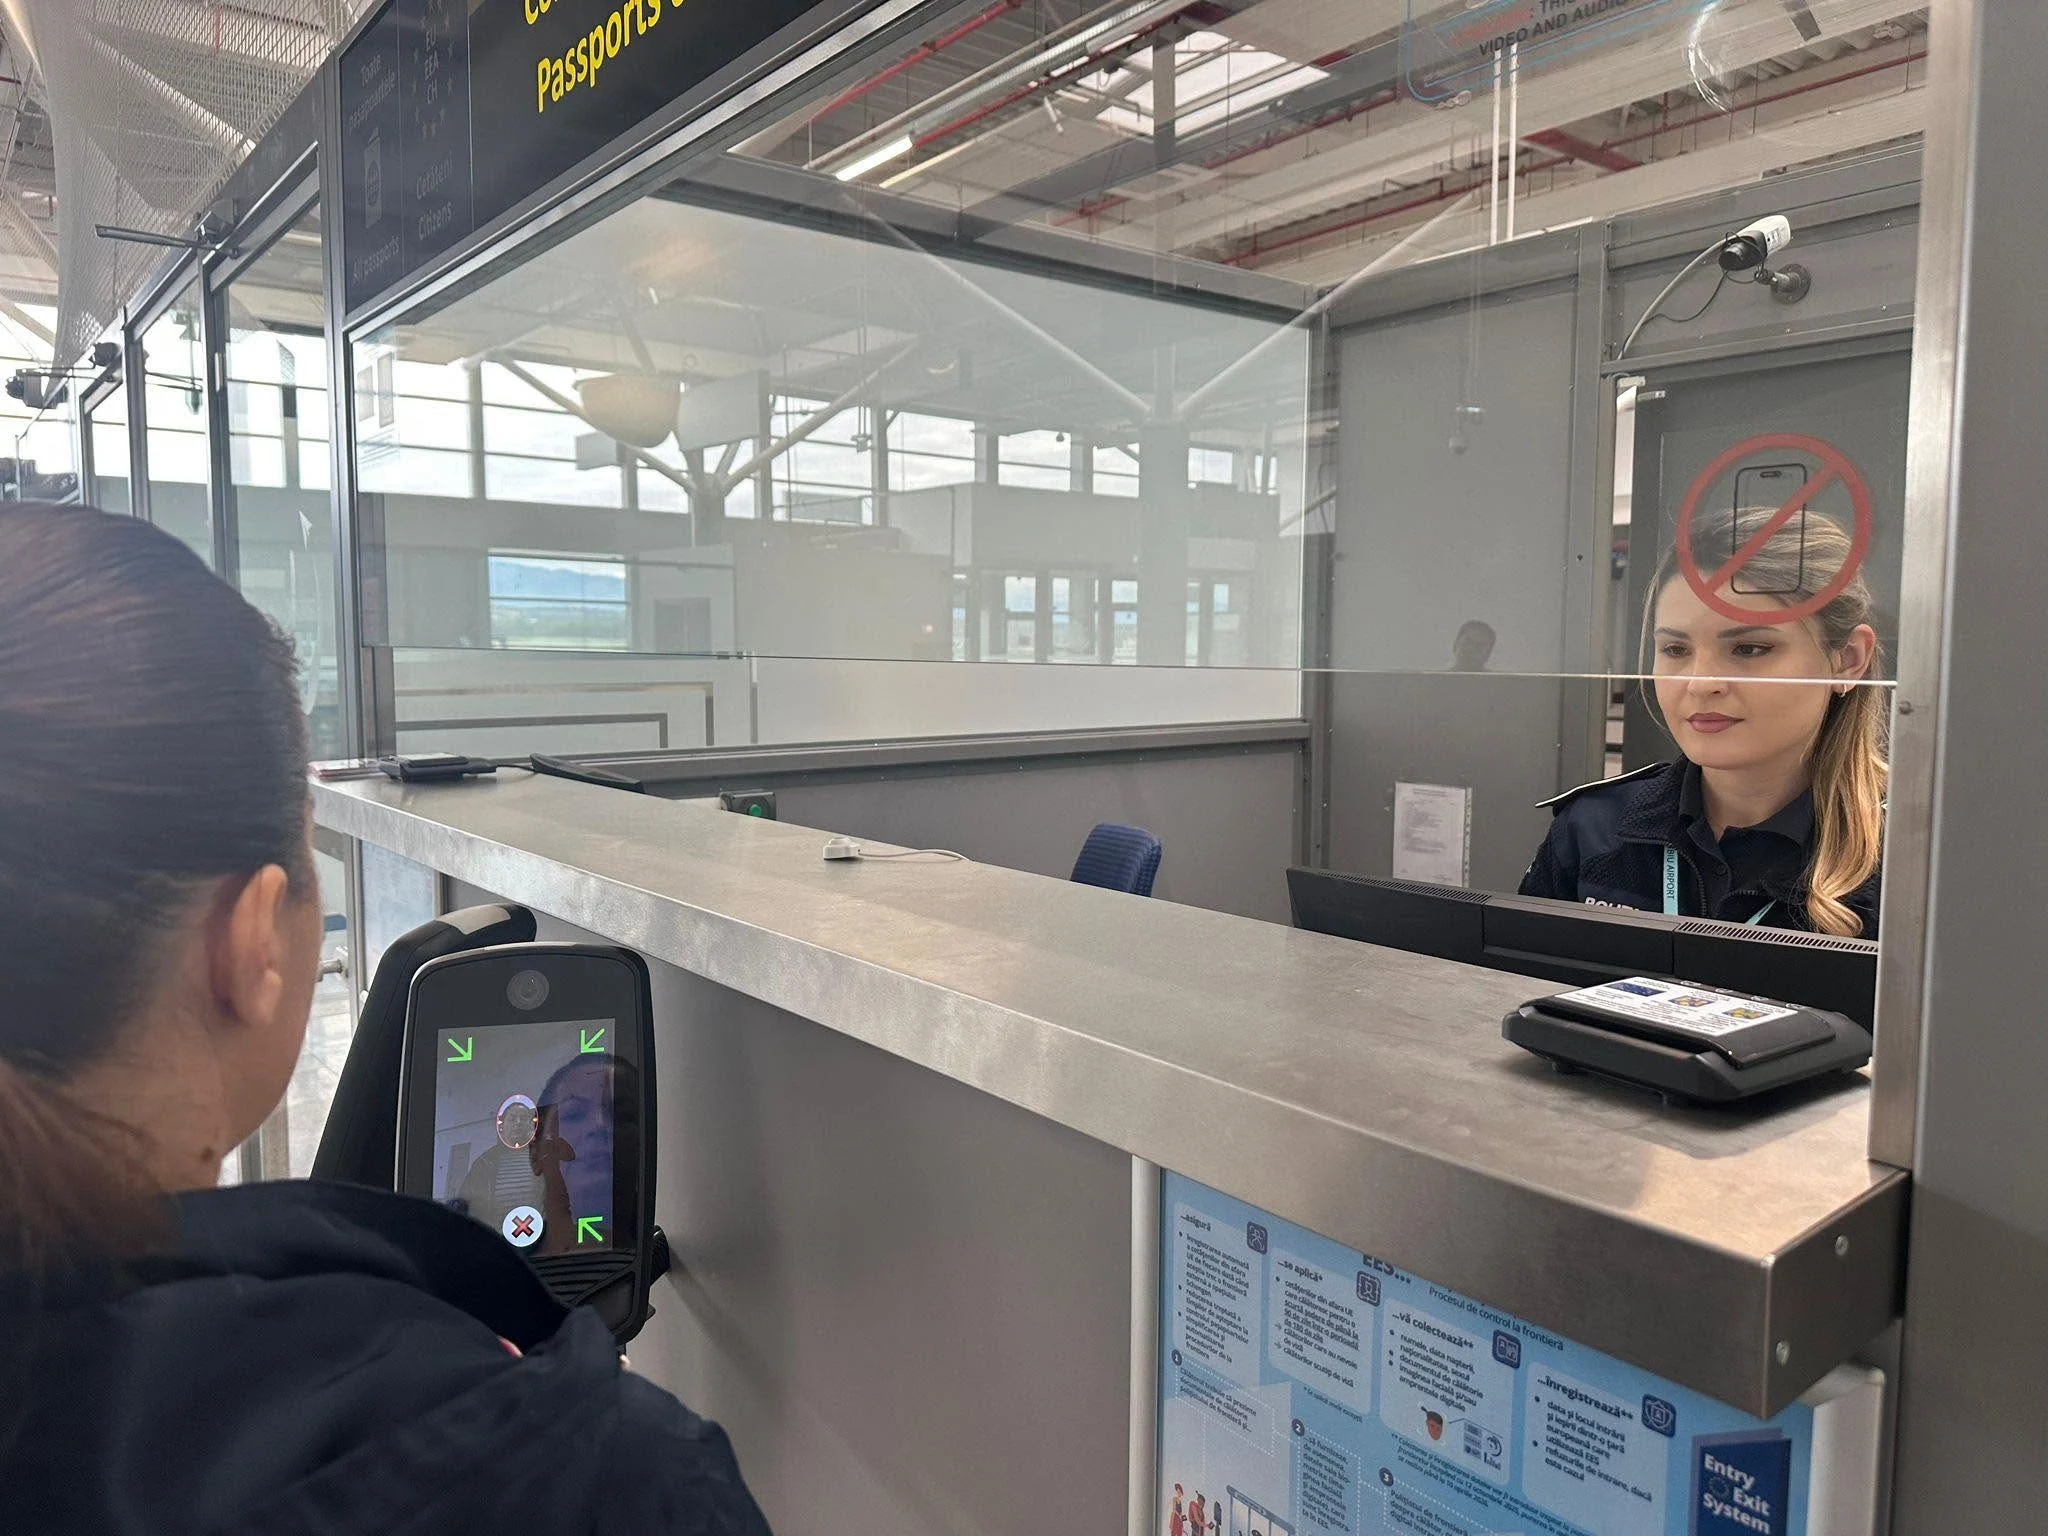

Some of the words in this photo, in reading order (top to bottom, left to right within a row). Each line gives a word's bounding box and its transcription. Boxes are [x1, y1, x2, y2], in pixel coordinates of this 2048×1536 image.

[1539, 0, 1576, 14] TH
[426, 25, 437, 52] EU
[1479, 28, 1528, 56] VIDEO
[1532, 13, 1567, 37] AND
[425, 51, 439, 81] EEA
[537, 0, 662, 113] Passports
[427, 79, 438, 105] CH
[418, 200, 453, 240] Citizens
[1667, 865, 1675, 900] AIRPORT
[1429, 1286, 1464, 1309] Procesul
[1466, 1302, 1477, 1314] de
[1480, 1309, 1510, 1328] control
[1512, 1321, 1520, 1332] la
[1522, 1325, 1563, 1350] frontieră
[1295, 1423, 1301, 1432] 2
[1547, 1401, 1566, 1414] data
[1575, 1412, 1594, 1428] locul
[1592, 1445, 1610, 1459] care
[1383, 1472, 1389, 1481] 3
[1704, 1452, 1755, 1491] Entry
[1703, 1493, 1770, 1535] System
[1733, 1489, 1770, 1518] Exit
